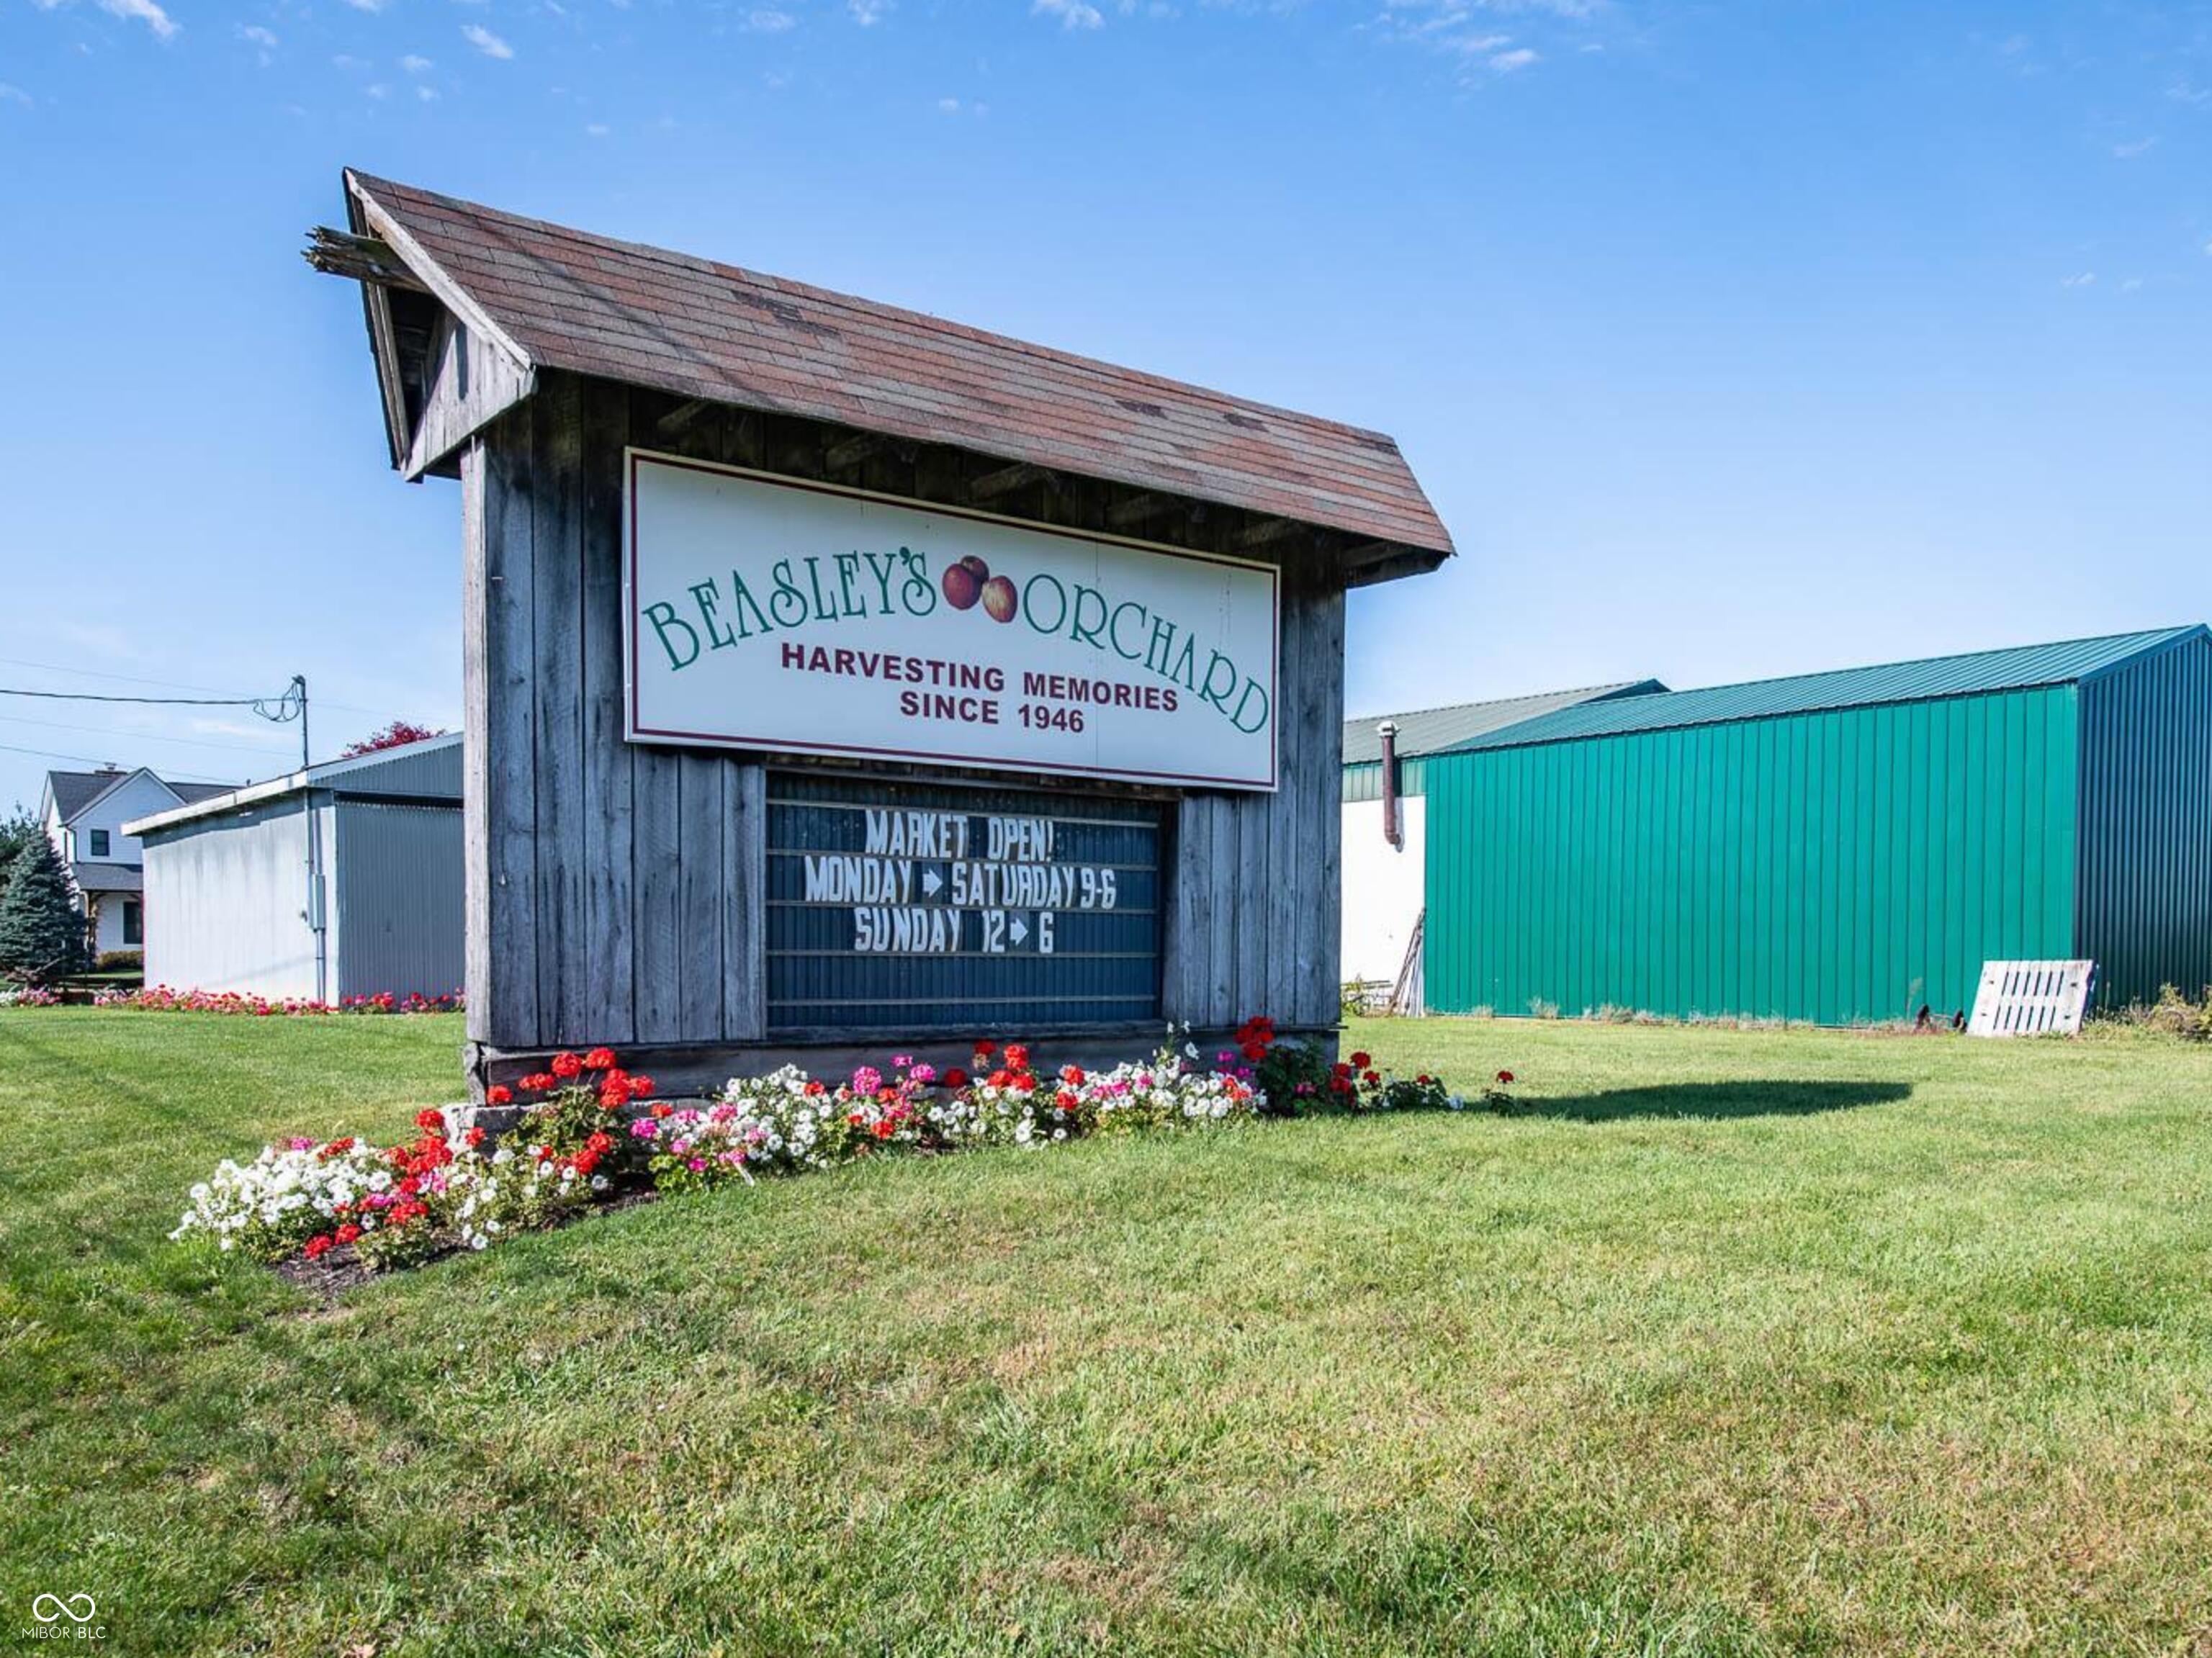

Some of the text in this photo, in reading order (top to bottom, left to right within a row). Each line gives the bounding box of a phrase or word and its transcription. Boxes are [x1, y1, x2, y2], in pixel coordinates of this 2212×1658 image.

[642, 546, 1269, 734] BEASLEY'S ORCHARD
[781, 642, 1178, 711] HARVESTING MEMORIES
[899, 692, 1084, 733] SINCE 1946
[865, 809, 1053, 862] MARKET OPEN!
[805, 856, 1116, 909] MONDAY SATURDAY 9-6
[854, 908, 1053, 953] SUNDAY 12 6
